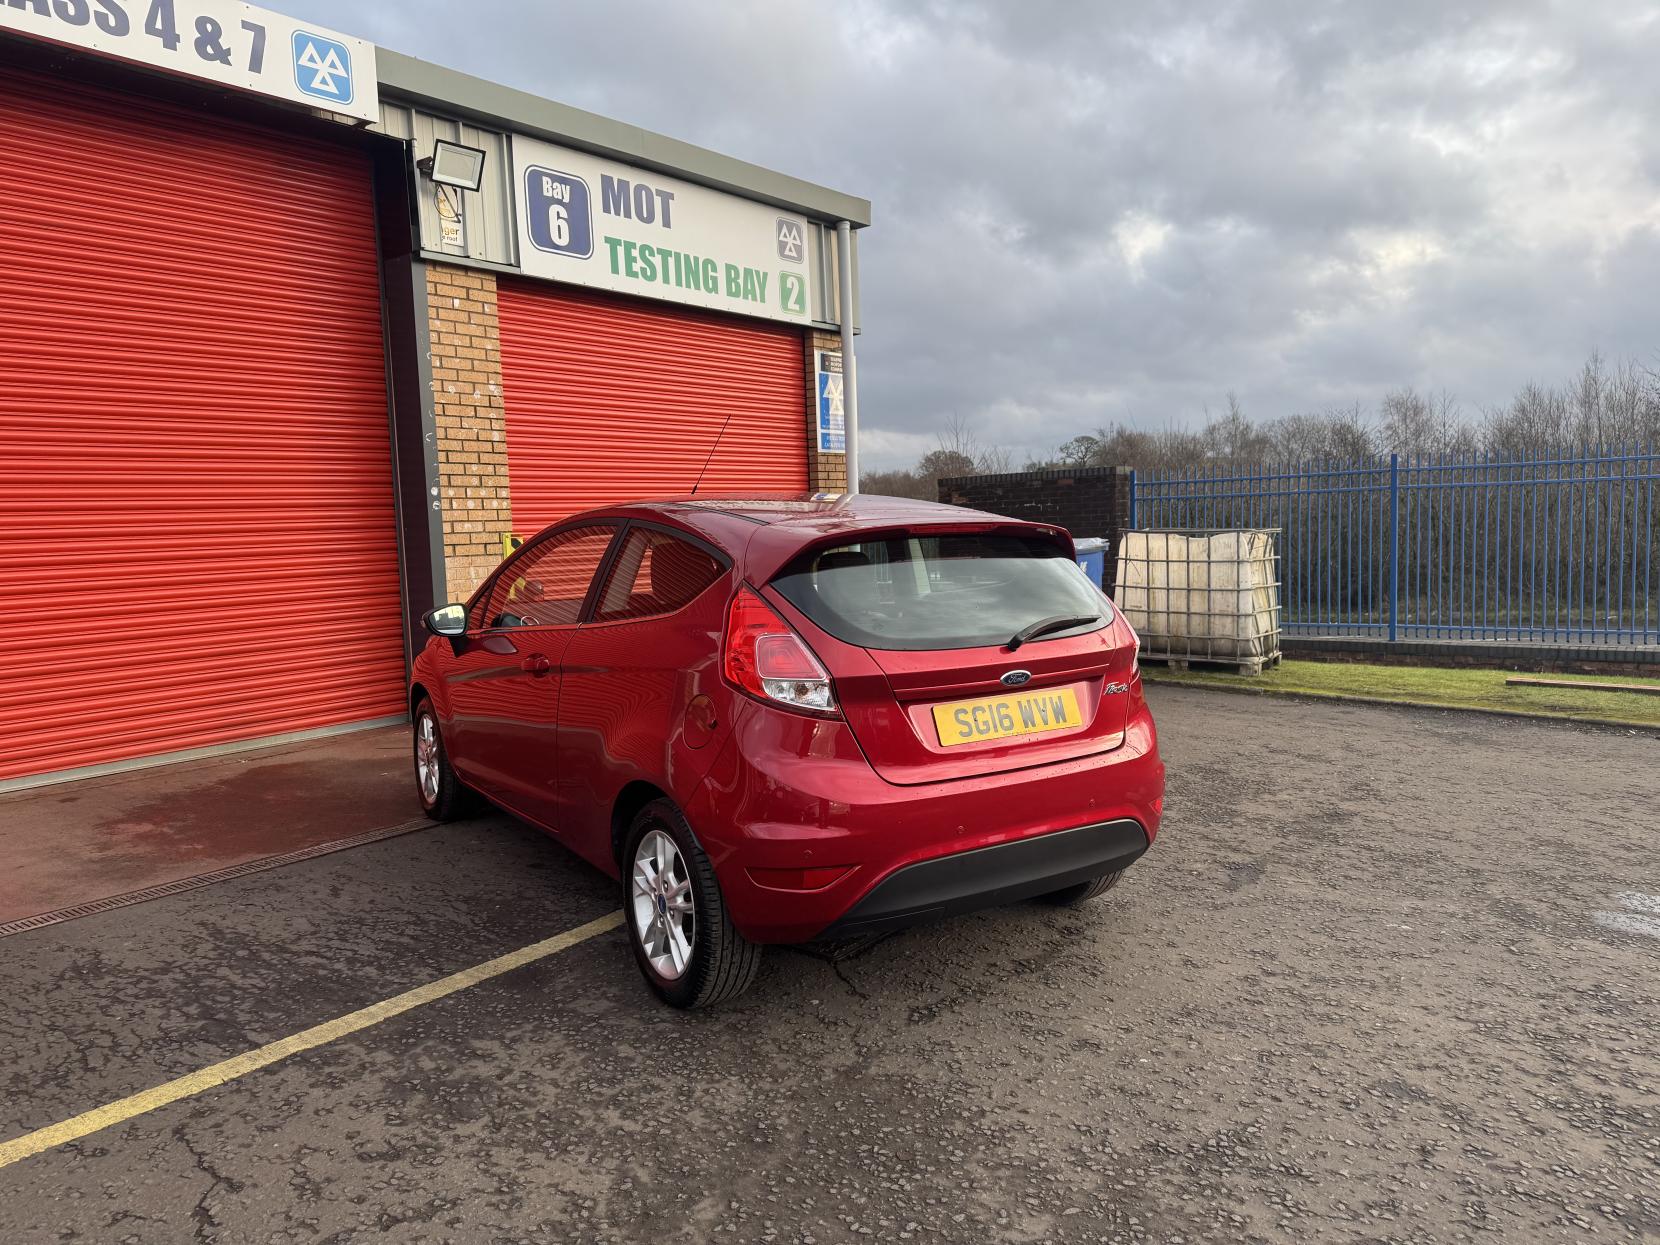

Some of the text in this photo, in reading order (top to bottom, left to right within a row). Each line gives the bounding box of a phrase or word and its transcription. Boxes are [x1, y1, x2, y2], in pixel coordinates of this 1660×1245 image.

[145, 0, 180, 51] 4
[194, 16, 232, 66] &
[241, 19, 266, 74] 7
[542, 176, 571, 204] Bay
[601, 174, 675, 229] MOT
[549, 204, 570, 247] 6
[604, 236, 769, 304] TESTING BAY
[787, 276, 801, 311] 2
[954, 696, 1067, 737] SG16 WVW
